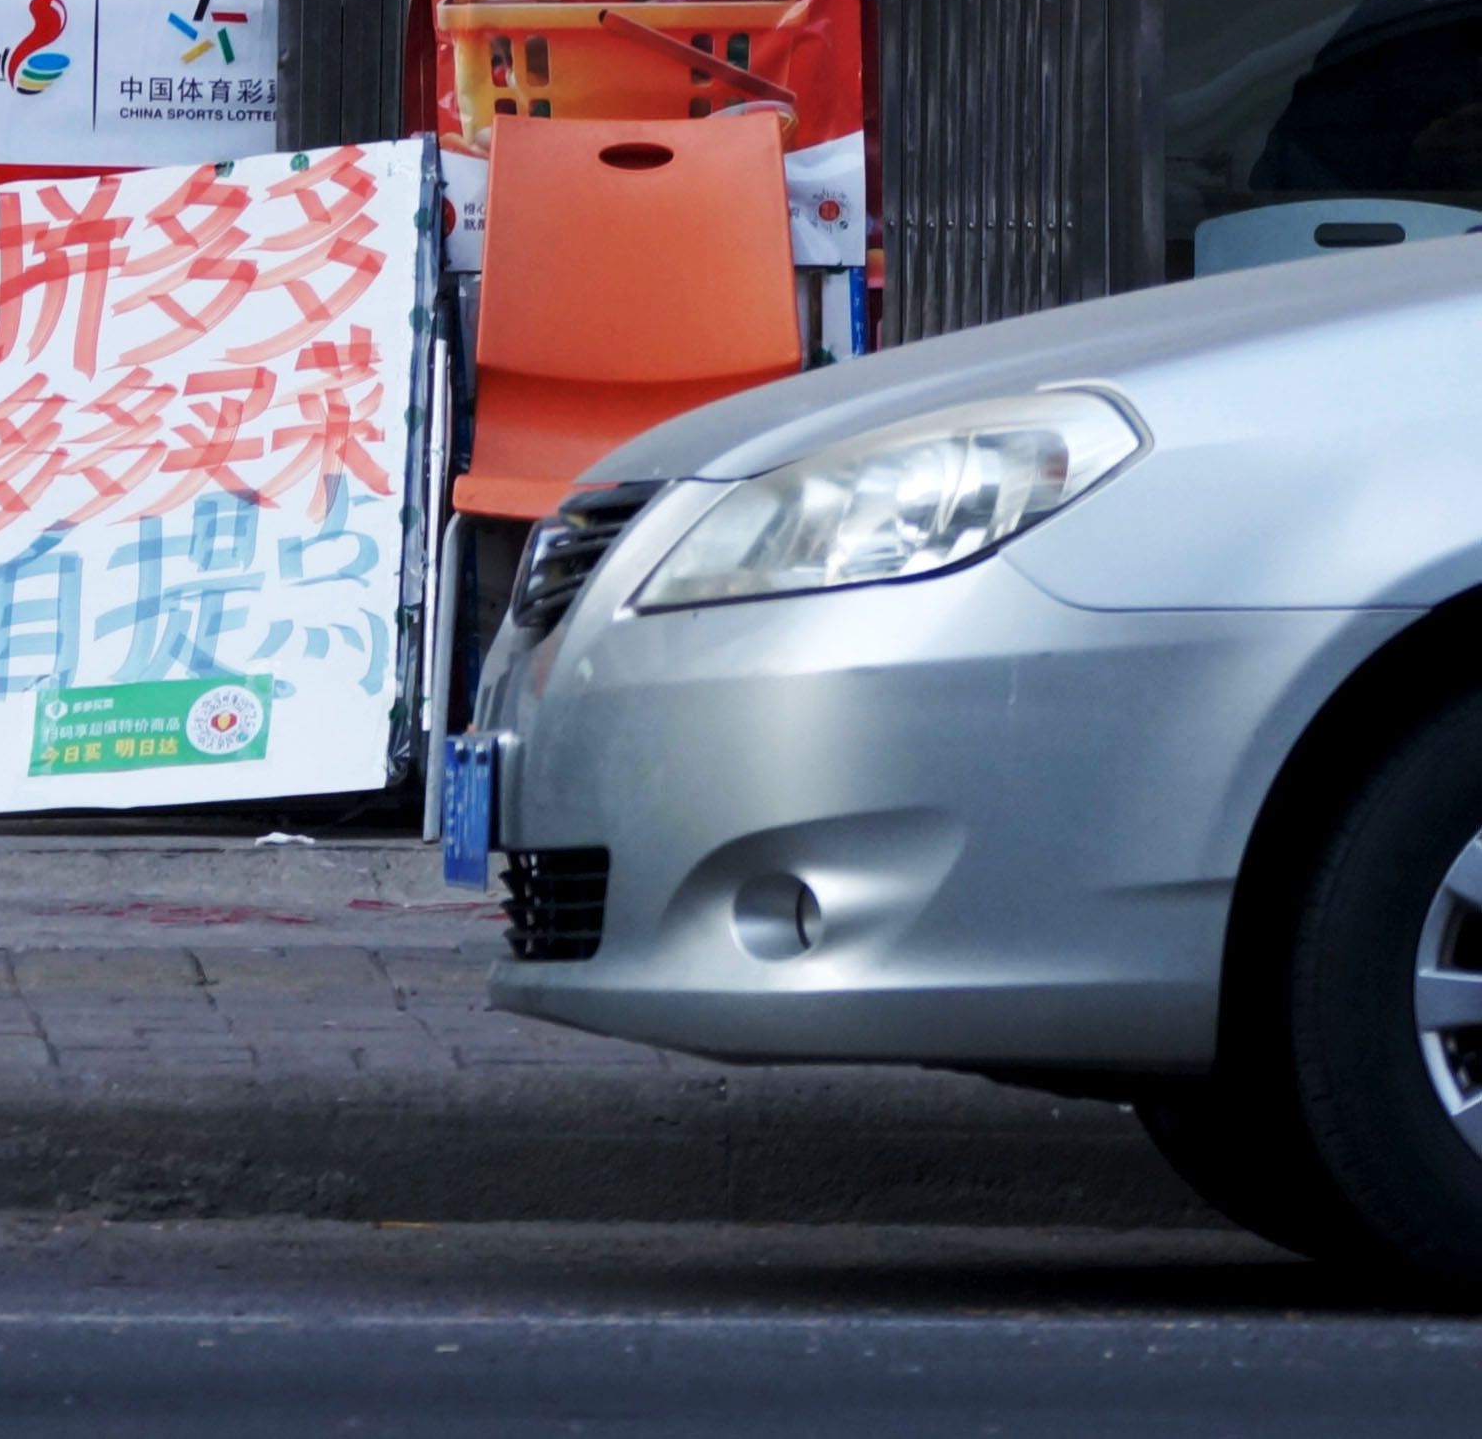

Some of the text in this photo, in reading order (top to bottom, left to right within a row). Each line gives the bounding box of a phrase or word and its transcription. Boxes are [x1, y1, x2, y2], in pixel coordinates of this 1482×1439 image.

[120, 107, 163, 120] CHINA
[167, 108, 223, 121] SPORTS
[39, 735, 179, 765] 今日买 明日达
